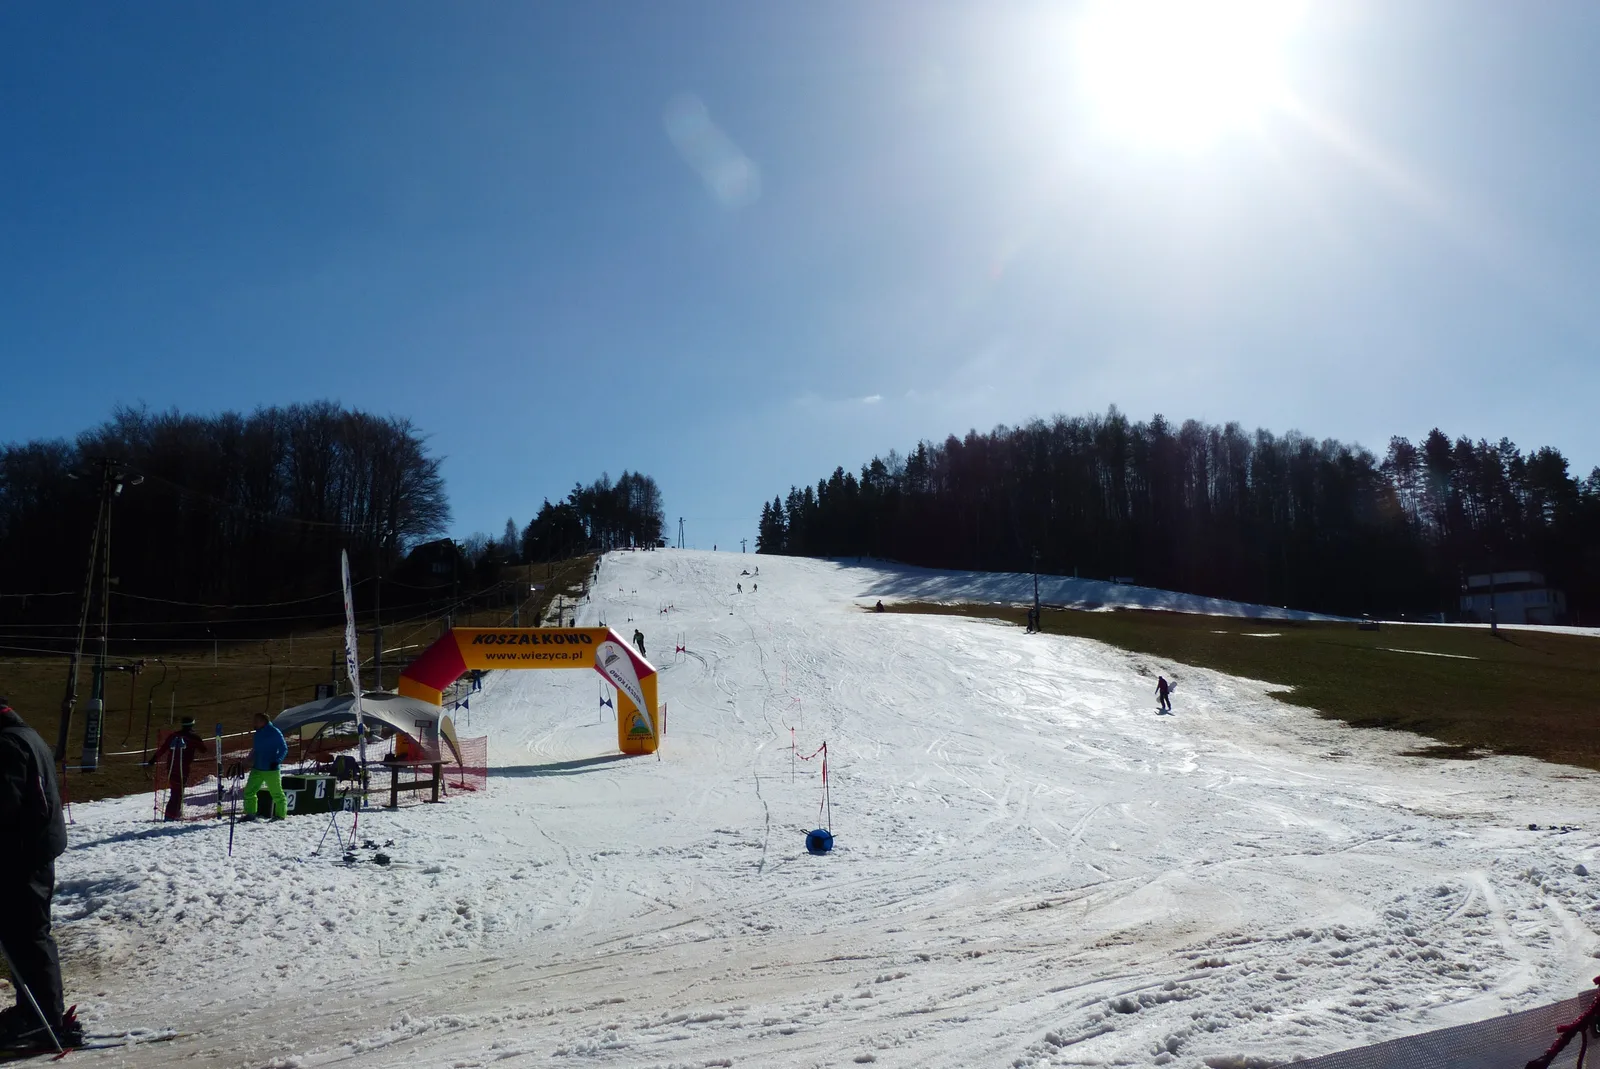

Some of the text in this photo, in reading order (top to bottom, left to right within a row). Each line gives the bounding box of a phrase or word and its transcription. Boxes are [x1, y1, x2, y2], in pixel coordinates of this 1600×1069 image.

[472, 633, 593, 645] KOSZAŁKOWO
[485, 651, 583, 661] www.wiezyca.pl
[87, 720, 98, 744] LECH
[287, 794, 295, 808] 2
